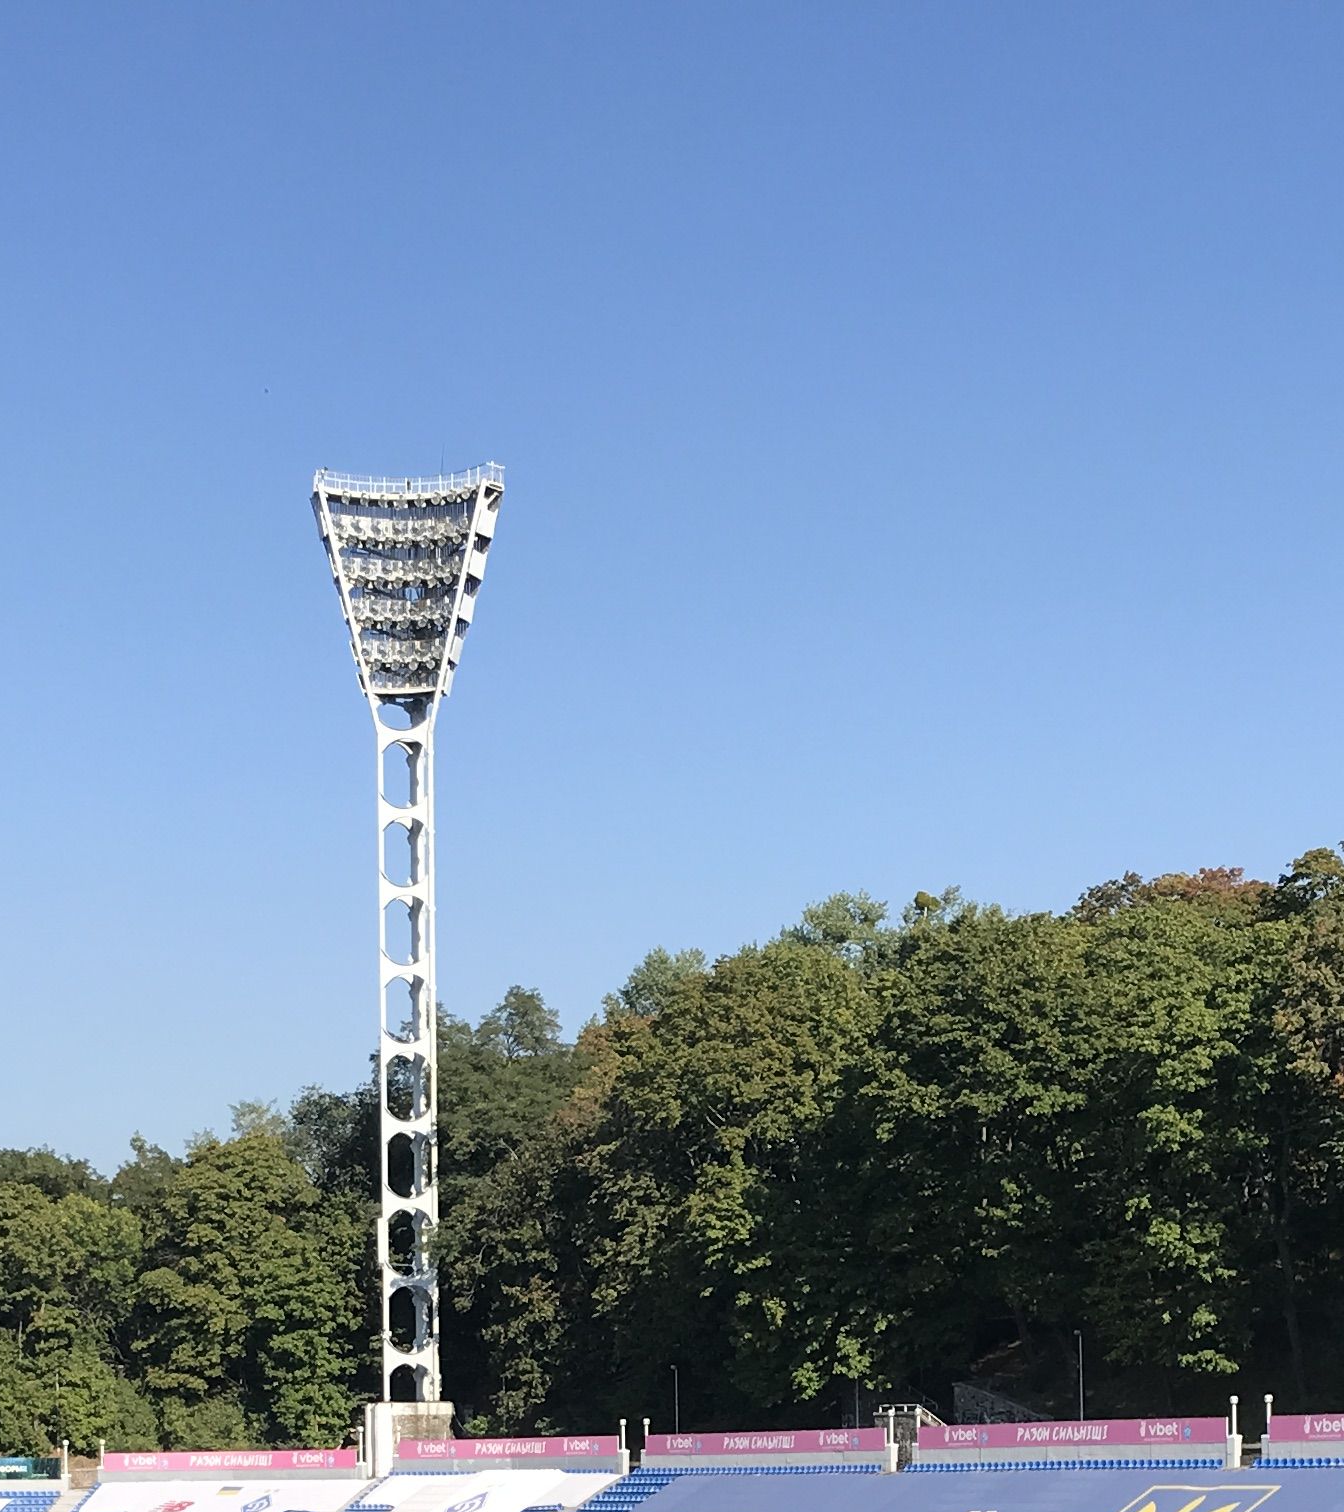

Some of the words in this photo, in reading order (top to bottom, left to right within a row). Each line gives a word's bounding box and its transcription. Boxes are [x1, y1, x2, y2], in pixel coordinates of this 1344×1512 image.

[952, 1427, 977, 1441] vbet
[1017, 1426, 1051, 1442] РАЗОМ
[1053, 1425, 1109, 1442] СИЛЬНІШІ
[1148, 1421, 1178, 1436] vbet
[568, 1438, 590, 1450] vbet
[671, 1436, 693, 1449] vbet
[723, 1436, 750, 1450] РАЗОМ
[826, 1432, 849, 1446] vbet
[422, 1441, 446, 1454] vbet
[474, 1442, 504, 1455] РАЗОМ
[131, 1454, 156, 1466] vbet
[299, 1451, 324, 1464] vbet
